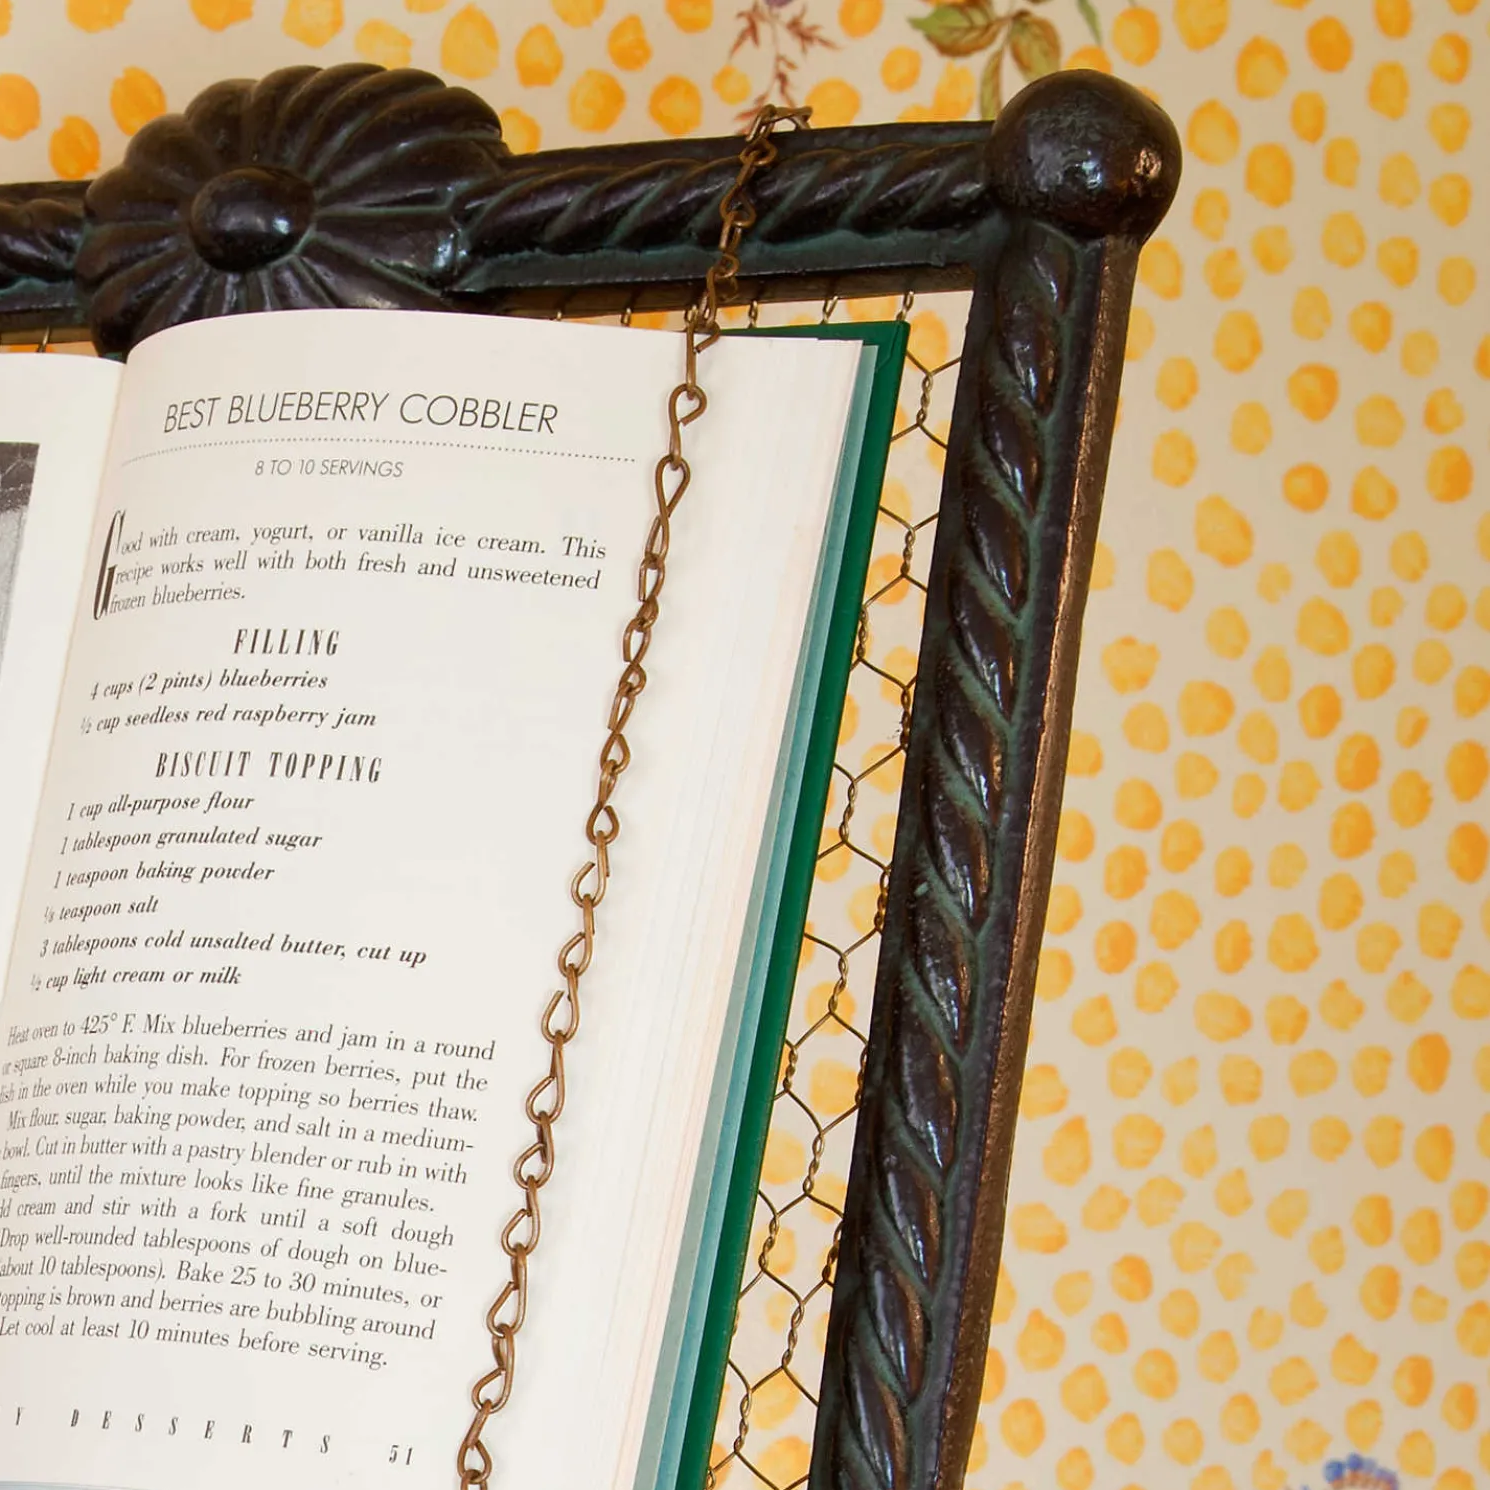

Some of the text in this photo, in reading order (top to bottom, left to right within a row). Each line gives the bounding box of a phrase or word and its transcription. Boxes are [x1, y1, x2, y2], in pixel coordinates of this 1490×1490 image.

[164, 392, 558, 434] BEST BLUEBERRY COBBLER
[255, 459, 403, 477] 8 TO 10 SERVINGS
[150, 526, 178, 548] with
[250, 525, 313, 546] yogurt,
[359, 523, 423, 544] vanilla
[434, 527, 466, 547] ice
[477, 537, 545, 554] cream.
[562, 536, 606, 559] This
[115, 549, 601, 589] recipe works well with both fresh and unsweetened
[152, 581, 245, 605] blueberries.
[233, 628, 339, 656] FILLING
[103, 668, 328, 700] cups (2 pints) blueberries
[97, 703, 376, 734] cup seedless red raspberry jam
[155, 750, 382, 783] BISCUIT TOPPING
[79, 790, 255, 821] cup all-purpose flour
[72, 825, 322, 852] tablespoon granulated sugar
[66, 860, 275, 888] teaspoon baking powder
[59, 895, 158, 924] teaspoon salt
[52, 929, 427, 968] tablespoons cold unsalted butter, cut up
[46, 965, 241, 992] cup light cream milk
[32, 1014, 495, 1060] oven Mix blueberries and jam round
[52, 1043, 488, 1091] 8-inch baking dish. For frozen berries, put the
[55, 1073, 477, 1121] oven while you make topping berries thaw.
[113, 1104, 474, 1152] baking powder, and salt medium-
[35, 1132, 467, 1184] Cut butter with pastry blender rub with
[49, 1164, 434, 1211] until the mixture looks like fine granules.
[17, 1194, 453, 1251] cream and stir with fork until soft dough
[0, 1224, 447, 1276] Drop well-rounded tablespoons dough blue-
[61, 1254, 409, 1308] tablespoons). Bake 25 30 minutes,
[66, 1285, 115, 1308] brown
[120, 1288, 155, 1309] and
[159, 1289, 224, 1315] berries
[229, 1304, 260, 1319] are
[265, 1299, 358, 1336] bubbling
[362, 1319, 435, 1340] around
[25, 1314, 387, 1370] cool least 10 minutes before serving.
[70, 1407, 331, 1455] DESSERTS
[387, 1443, 415, 1467] 51
